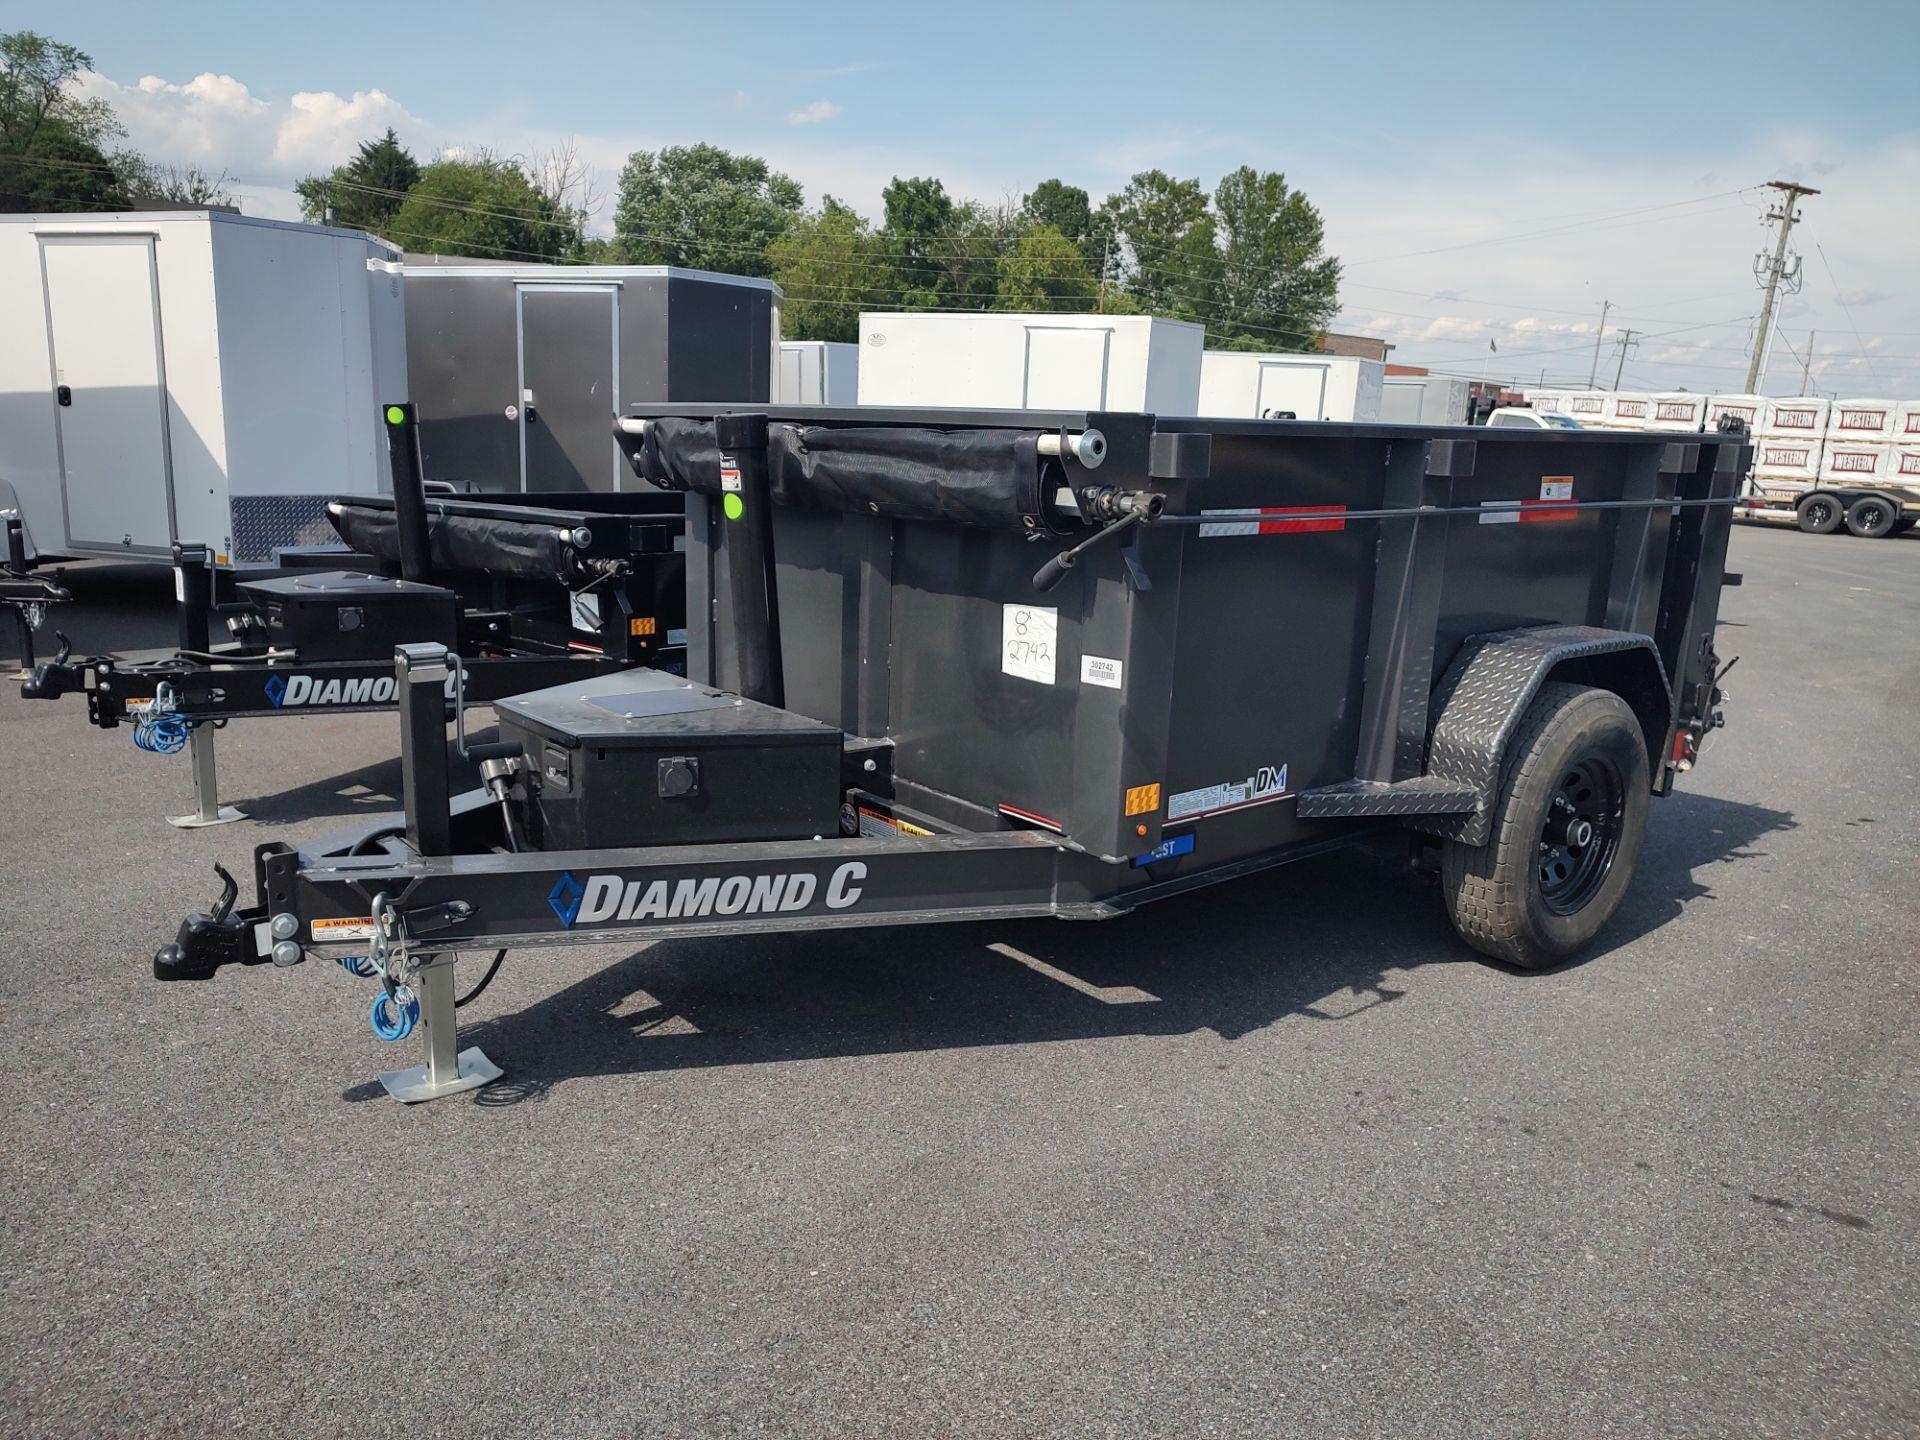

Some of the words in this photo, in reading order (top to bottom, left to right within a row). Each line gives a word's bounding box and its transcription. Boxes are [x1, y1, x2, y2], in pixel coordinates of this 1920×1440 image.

[1777, 410, 1814, 427] WESTERN
[1842, 412, 1884, 429] WESTERN
[1766, 449, 1807, 466] WESTERN
[1834, 454, 1875, 471] WESTERN
[1008, 640, 1051, 664] 2742
[282, 675, 400, 705] DIAMO
[1255, 764, 1287, 792] DM
[1155, 840, 1176, 858] ST
[576, 873, 817, 923] DIAMOND
[825, 861, 867, 909] C
